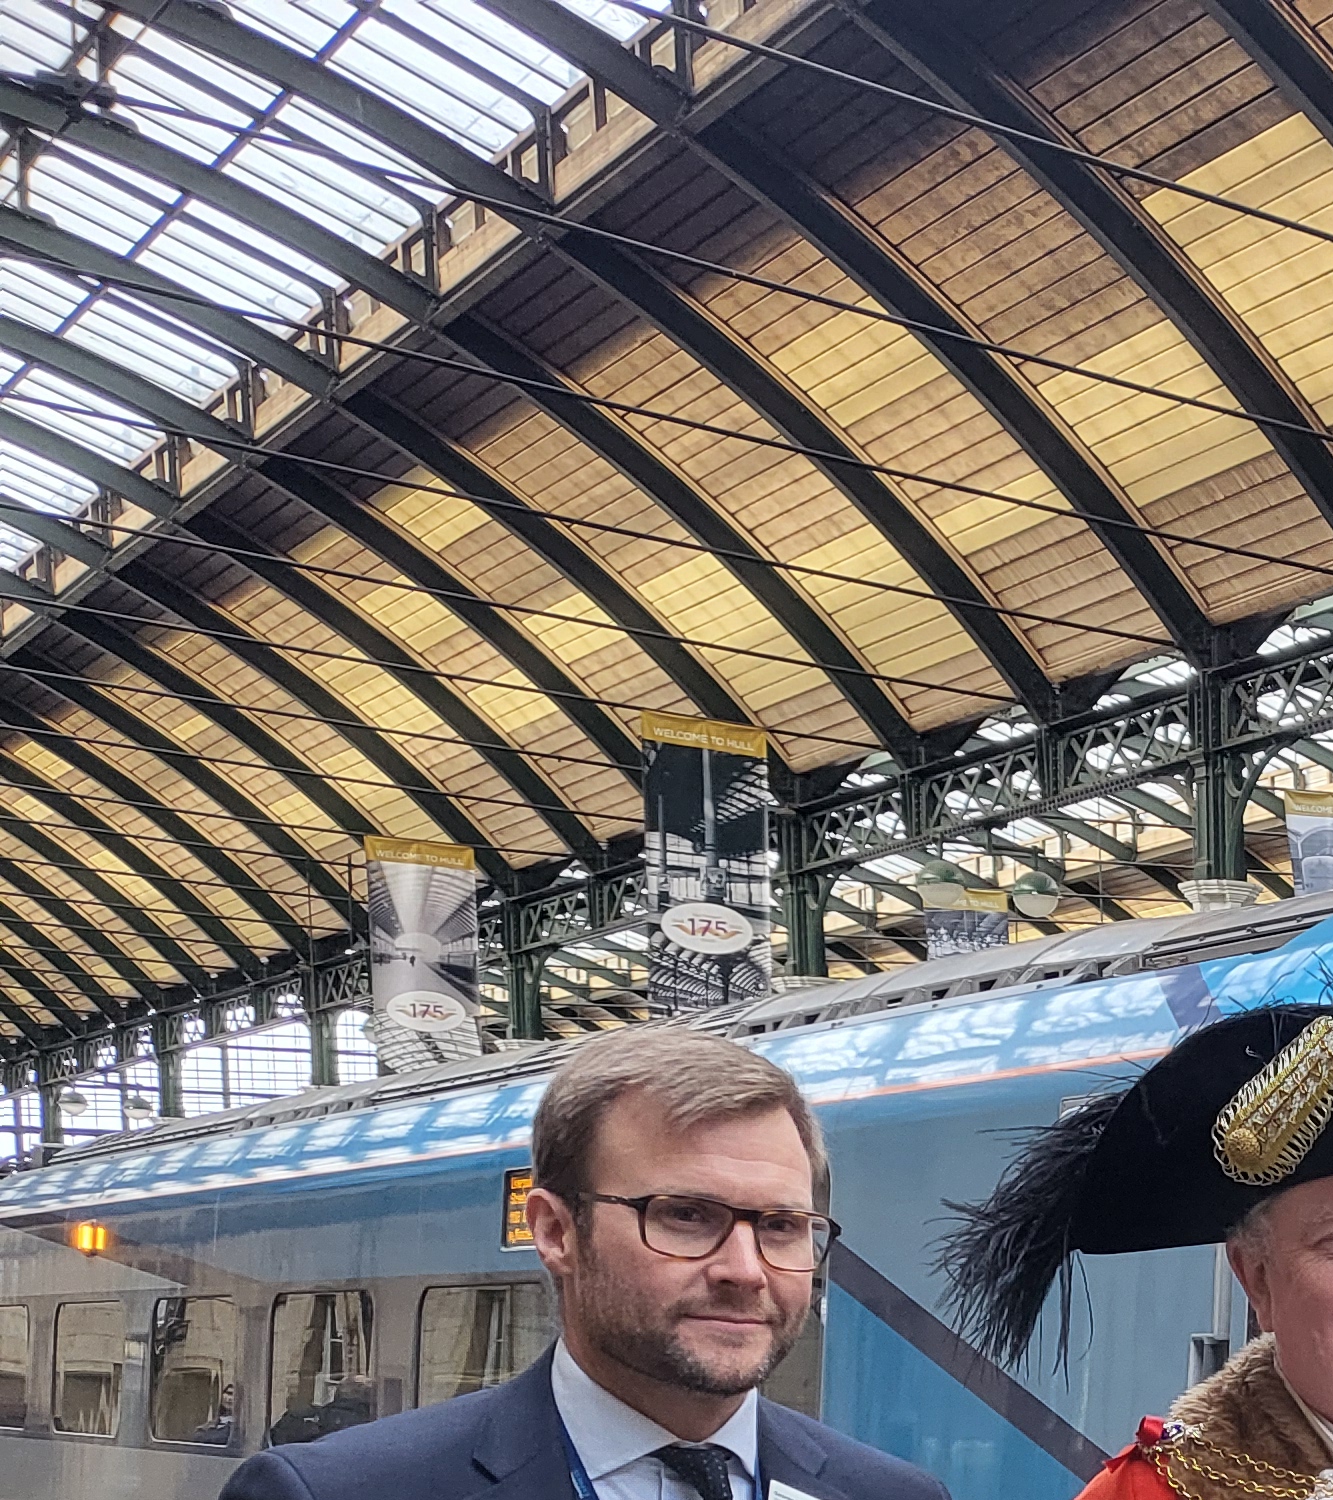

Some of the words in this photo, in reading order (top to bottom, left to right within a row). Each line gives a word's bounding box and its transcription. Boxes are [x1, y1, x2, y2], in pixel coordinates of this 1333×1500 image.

[653, 727, 709, 744] WELCOME
[710, 735, 725, 746] TO
[727, 738, 755, 751] HULL
[375, 849, 423, 861] WELCOME
[425, 854, 438, 863] TO
[440, 857, 465, 866] HULL
[687, 918, 728, 936] 175
[409, 1003, 444, 1018] 175
